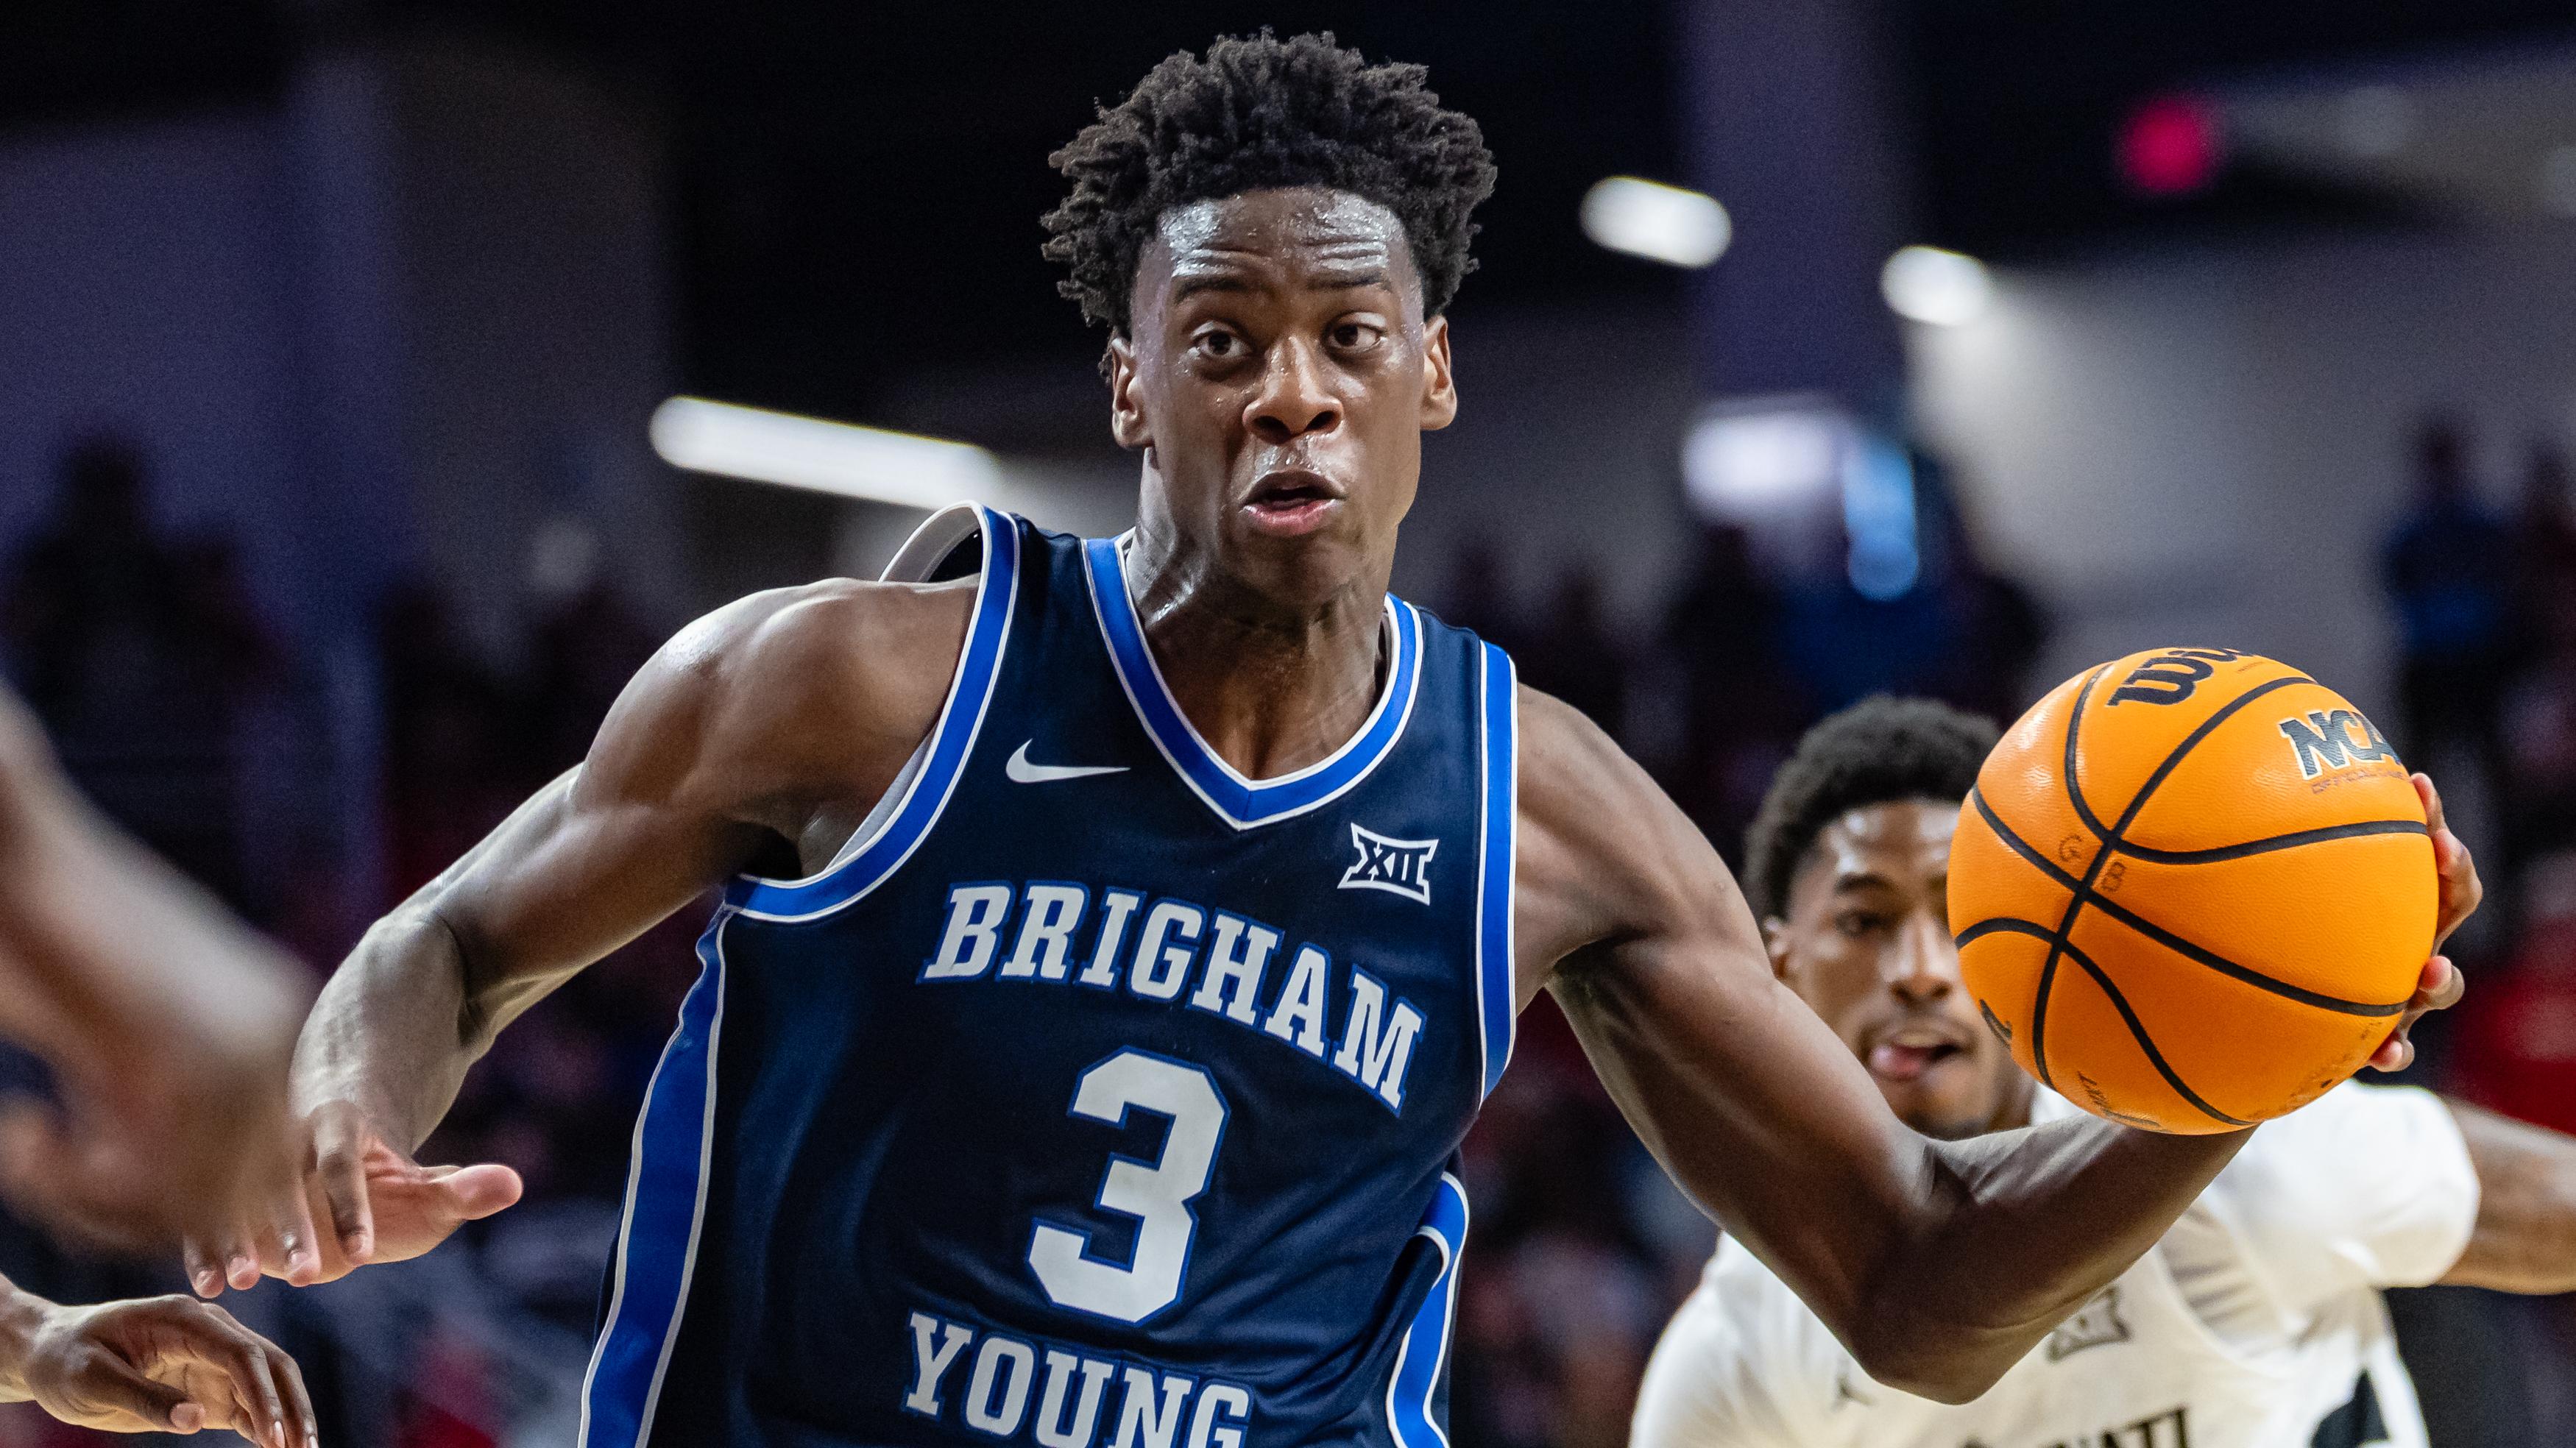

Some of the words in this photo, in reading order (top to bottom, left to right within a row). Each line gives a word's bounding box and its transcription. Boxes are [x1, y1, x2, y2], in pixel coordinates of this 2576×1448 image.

[918, 881, 1427, 1117] BRIGHAM
[1029, 1046, 1231, 1324] 3
[902, 1307, 1256, 1447] YOUNG
